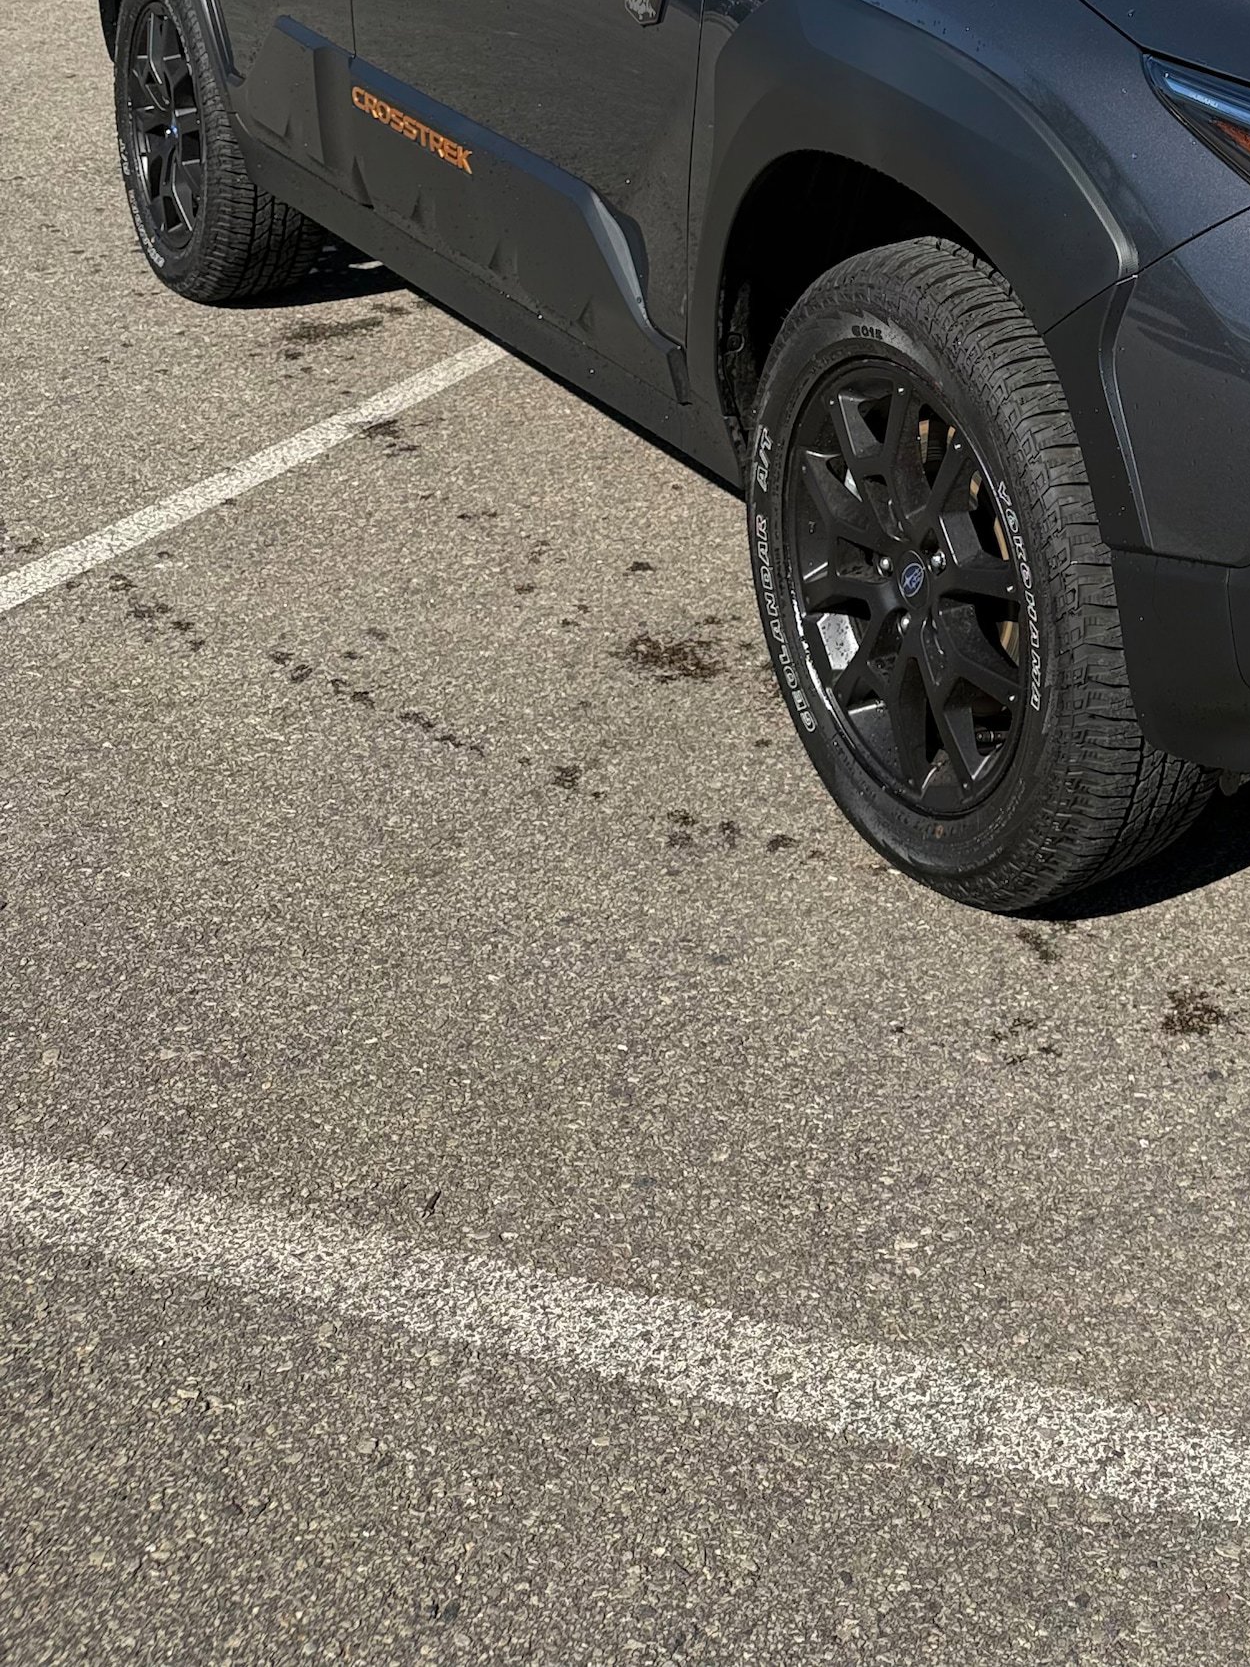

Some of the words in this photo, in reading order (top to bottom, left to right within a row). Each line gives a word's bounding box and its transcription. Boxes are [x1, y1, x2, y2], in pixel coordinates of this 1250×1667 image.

[352, 86, 474, 175] CROSSTREK
[756, 426, 773, 493] A/T
[756, 514, 817, 733] GEOLANDAR
[998, 480, 1042, 712] YOKOHAMA
